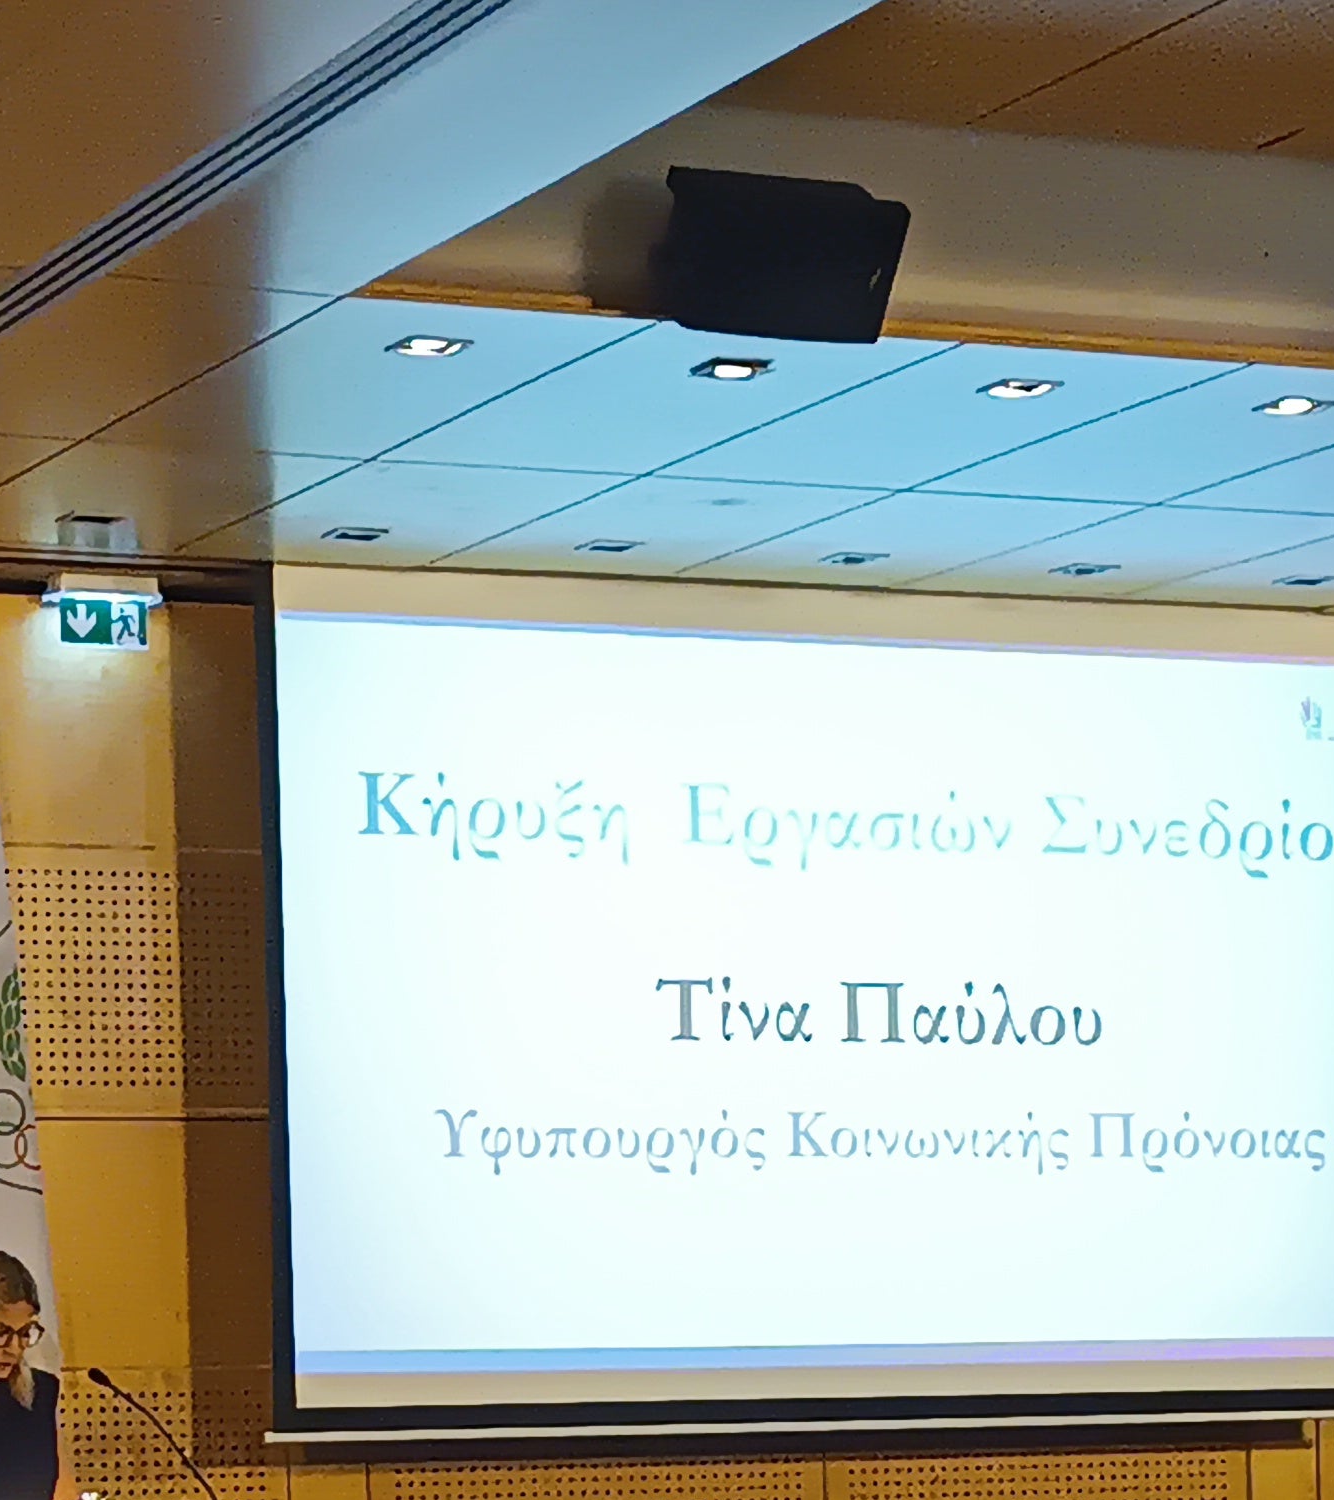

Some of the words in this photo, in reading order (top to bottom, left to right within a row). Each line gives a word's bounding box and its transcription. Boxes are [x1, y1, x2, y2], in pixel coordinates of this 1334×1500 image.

[356, 769, 631, 865] Κήρυξη
[684, 784, 1014, 872] Εργασιών
[655, 975, 814, 1043] Τίνα
[838, 980, 1104, 1047] Παύλου
[432, 1108, 768, 1177] Υφυπουργός
[786, 1110, 1071, 1176] Κοινωνικής
[1088, 1110, 1328, 1175] Πρόνοιας
